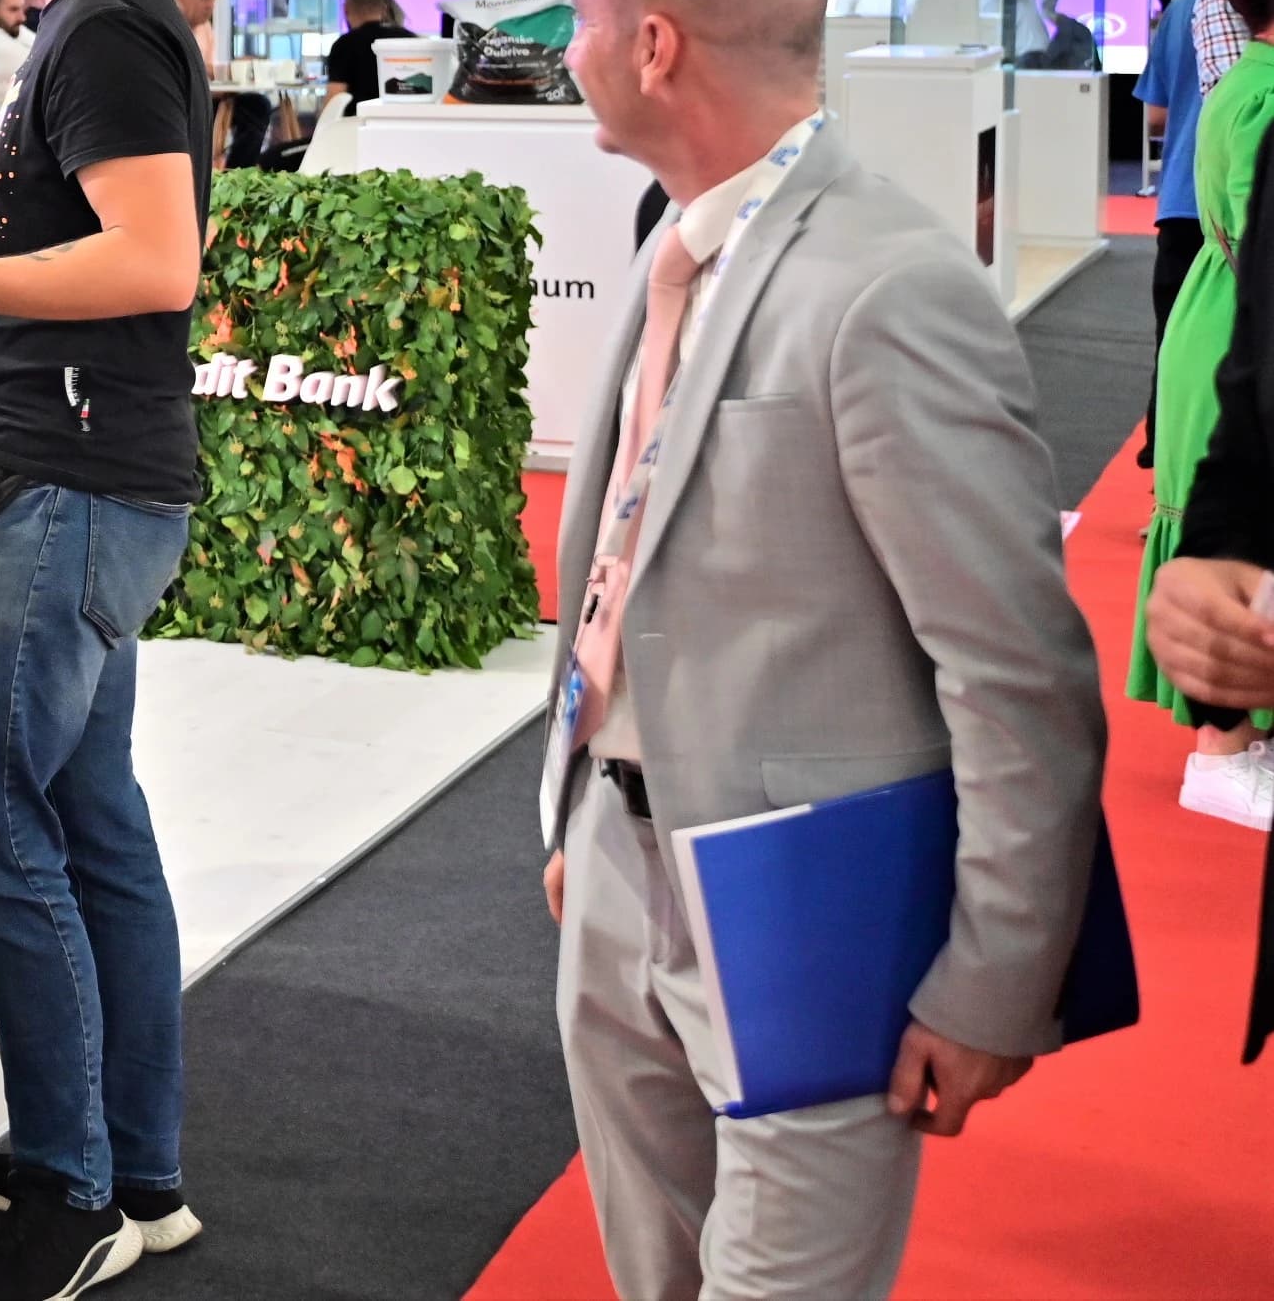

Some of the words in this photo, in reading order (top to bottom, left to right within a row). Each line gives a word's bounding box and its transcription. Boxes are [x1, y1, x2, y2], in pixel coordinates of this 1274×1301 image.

[529, 278, 595, 299] um
[191, 352, 258, 399] dit
[262, 353, 402, 412] Bank
